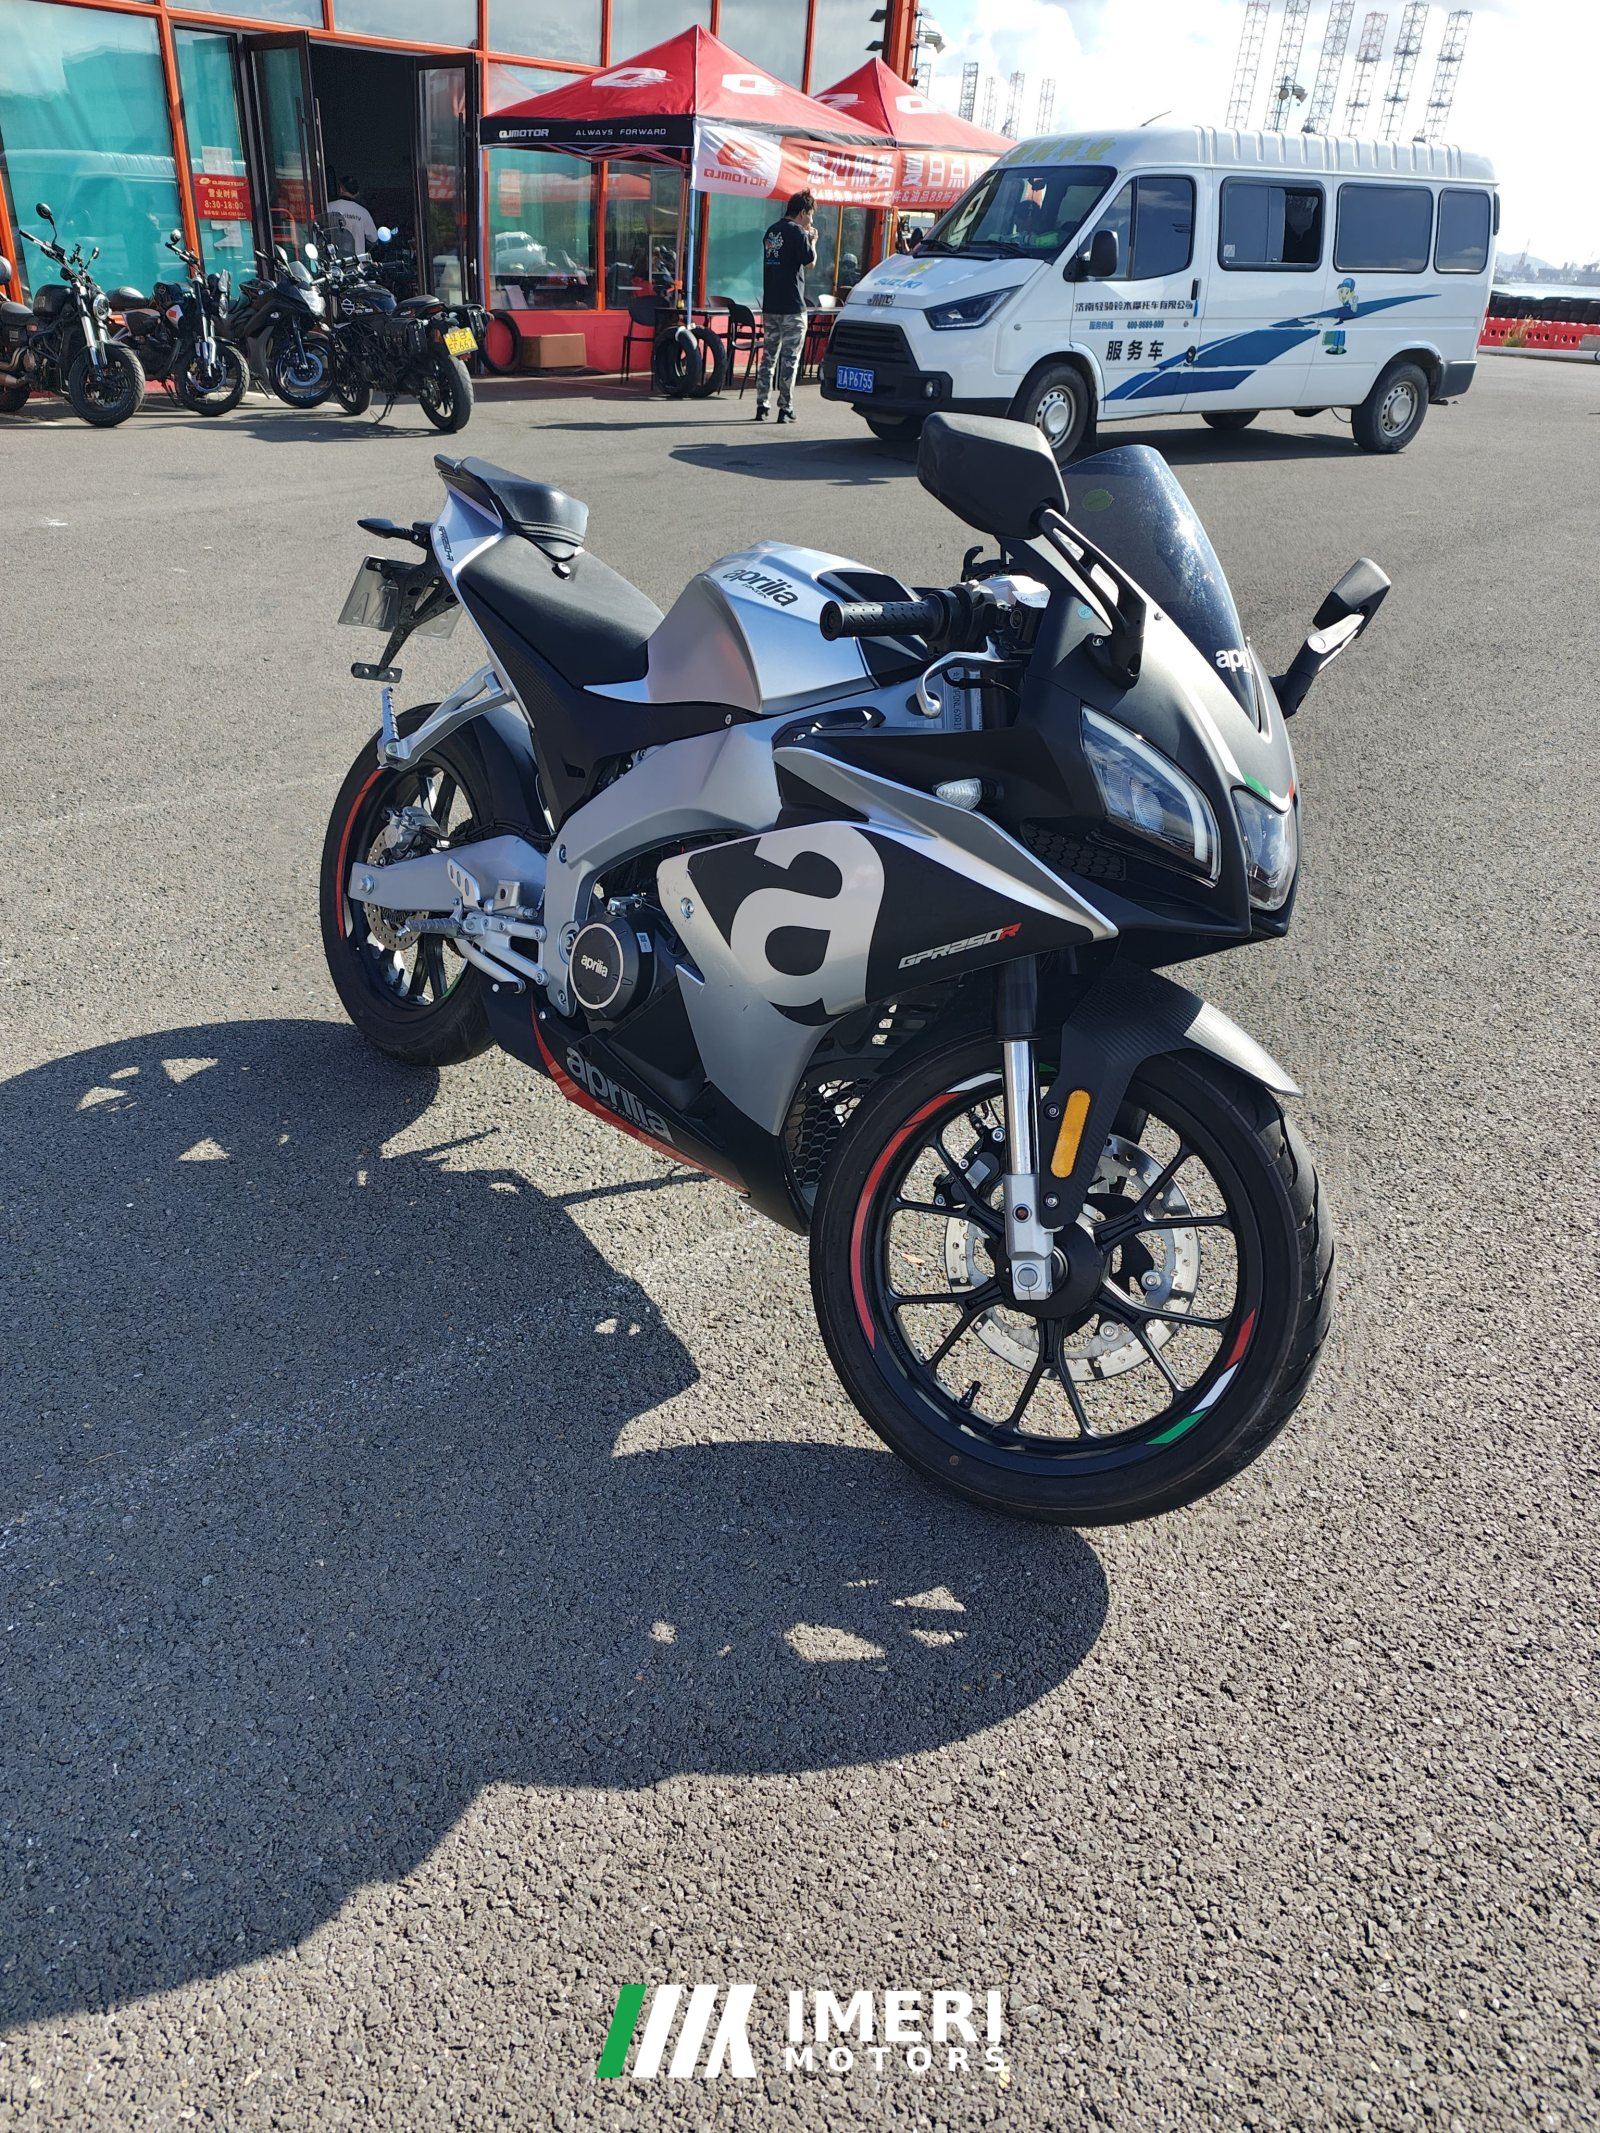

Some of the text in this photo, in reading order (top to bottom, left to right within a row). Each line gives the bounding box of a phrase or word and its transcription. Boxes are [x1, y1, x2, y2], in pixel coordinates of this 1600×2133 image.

[575, 127, 667, 136] ALWAYS FORWARD
[703, 168, 769, 188] QJMOTOR
[207, 188, 239, 199] 营业时间
[204, 200, 244, 210] 8:30-18:00
[1106, 339, 1164, 361] 服务车
[722, 569, 799, 607] aprilia
[898, 922, 1022, 970] GPR250R
[580, 954, 609, 978] aprilia
[566, 1046, 675, 1144] aprilia
